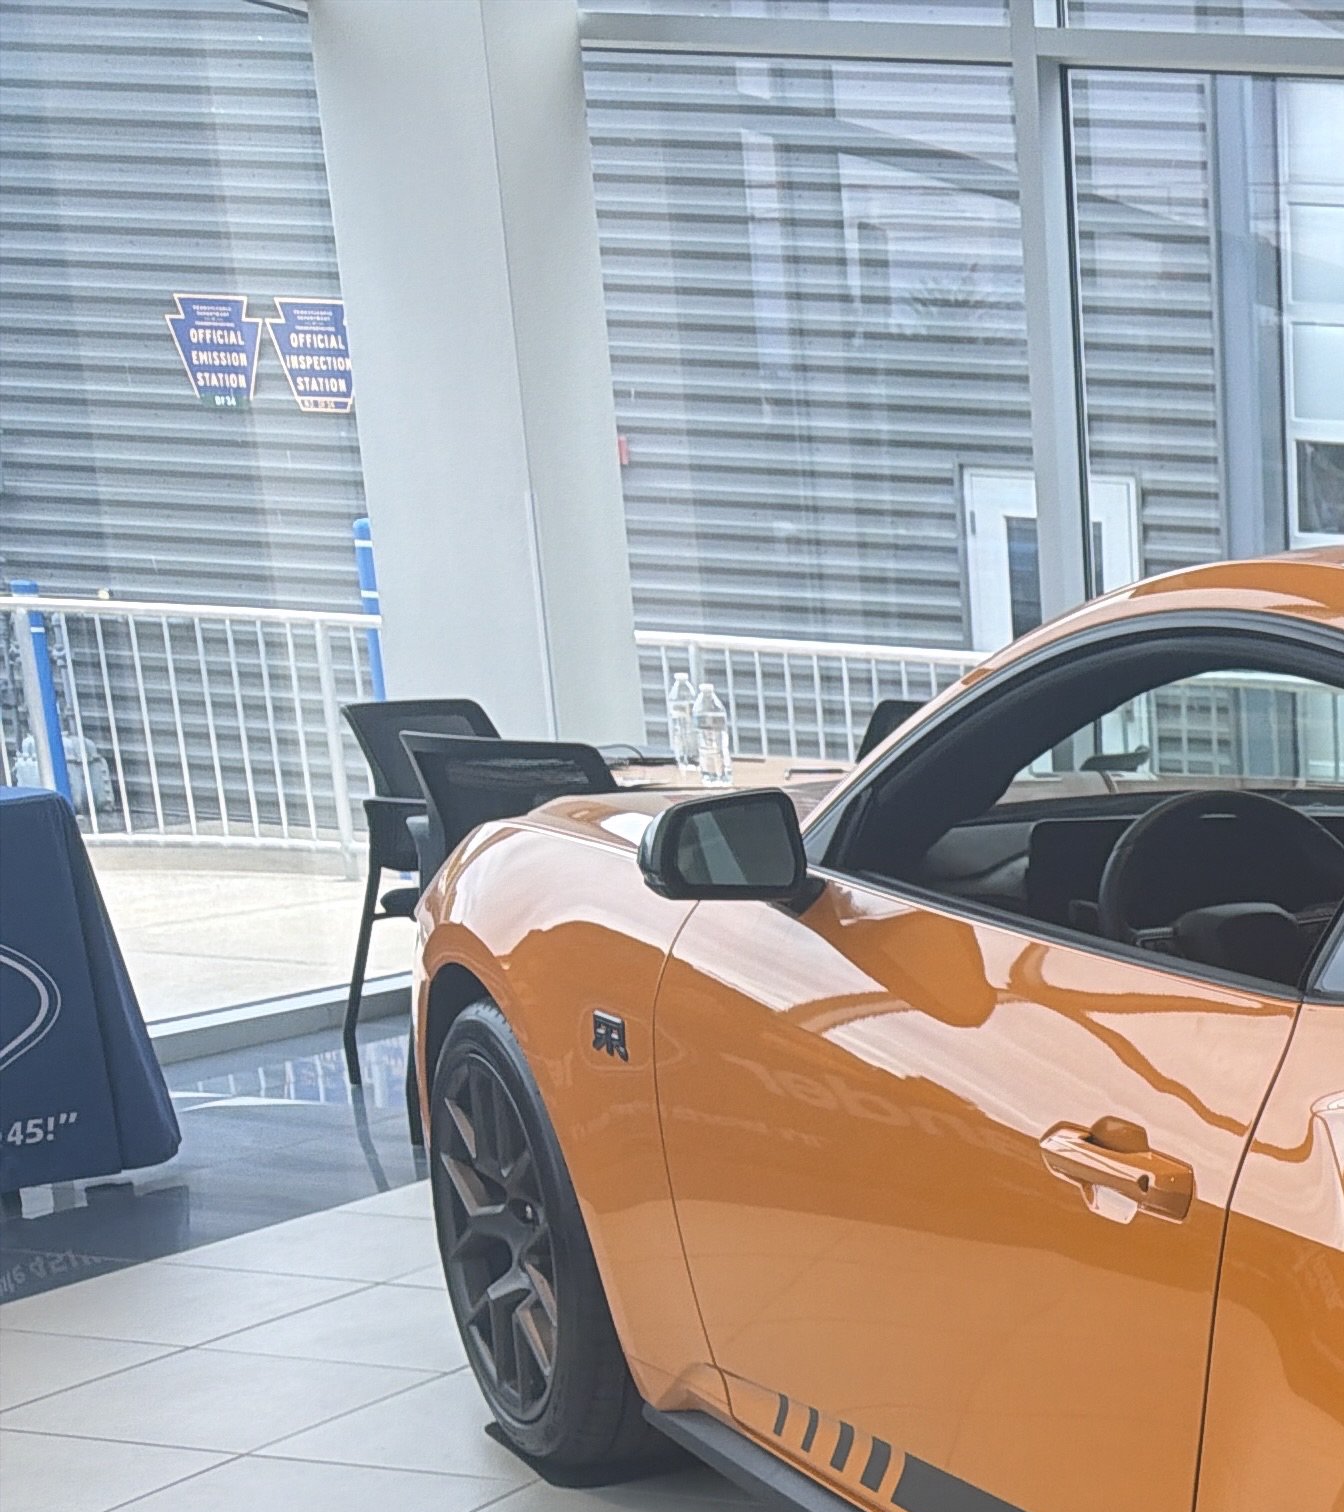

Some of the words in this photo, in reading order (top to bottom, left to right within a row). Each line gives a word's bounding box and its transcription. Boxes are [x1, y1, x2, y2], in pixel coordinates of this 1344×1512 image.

[189, 328, 245, 346] OFFICIAL
[289, 332, 346, 350] OFFICIAL
[191, 350, 248, 367] EMISSION
[285, 354, 352, 371] INSPECTION
[196, 372, 247, 388] STATION
[296, 376, 347, 393] STATION
